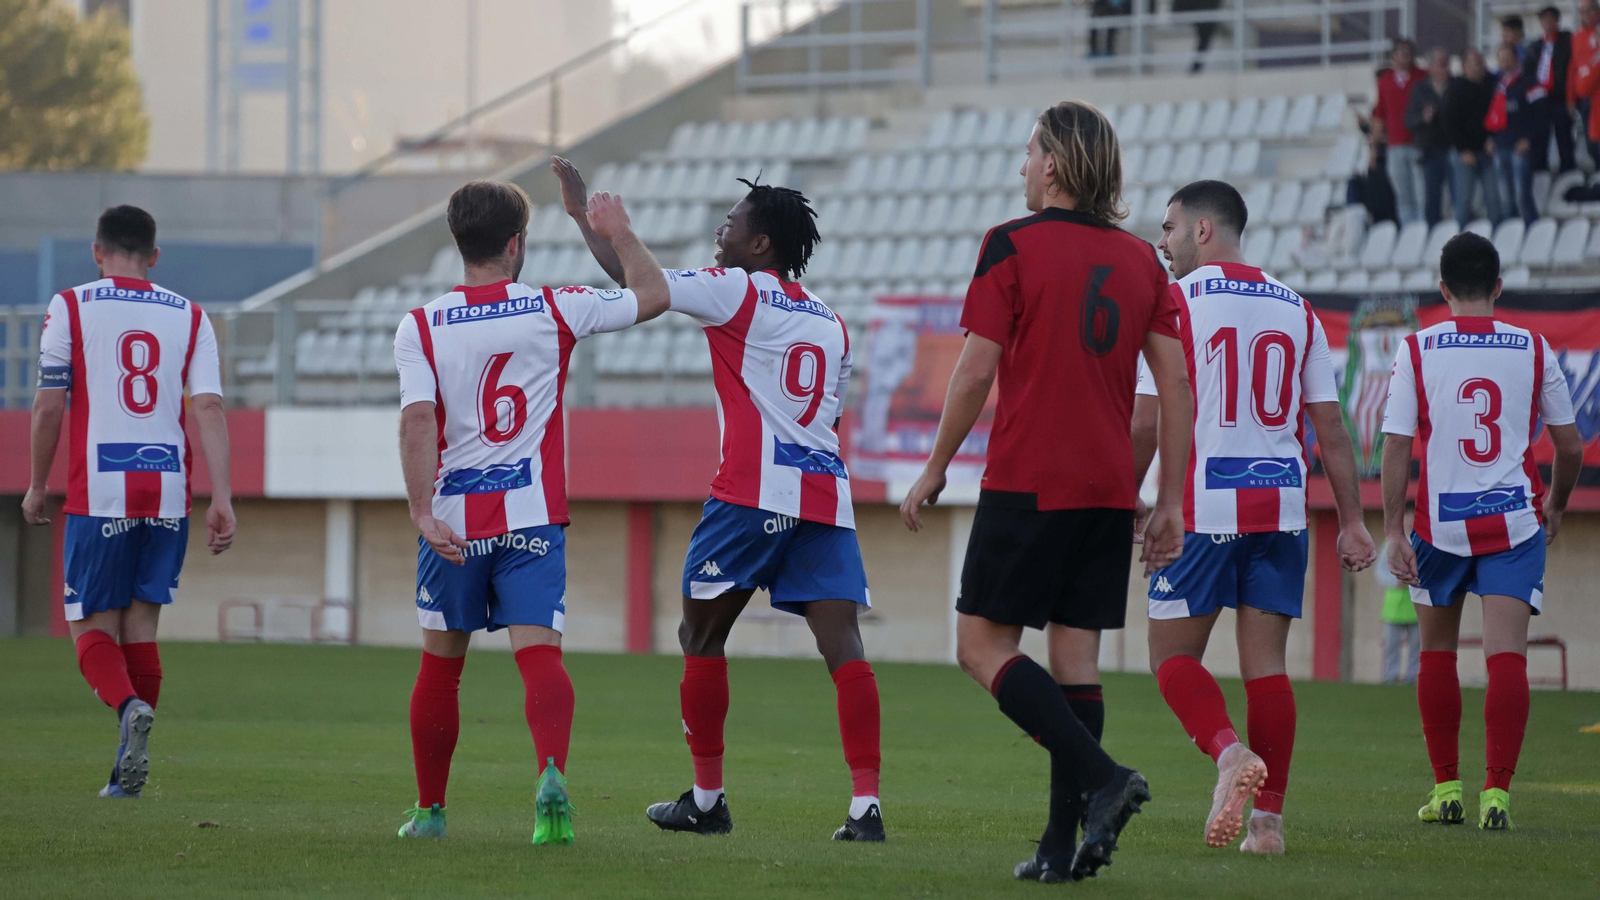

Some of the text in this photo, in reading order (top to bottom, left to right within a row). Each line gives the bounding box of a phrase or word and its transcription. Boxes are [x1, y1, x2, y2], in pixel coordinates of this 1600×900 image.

[99, 287, 184, 305] STOP-FLUID
[1210, 279, 1298, 301] STOP-FLUID
[451, 299, 541, 319] STOP-FLUID
[1079, 264, 1120, 358] 6
[1441, 334, 1526, 346] STOP-FLUID
[116, 329, 160, 418] 8
[780, 341, 826, 428] 9
[1205, 327, 1296, 432] 10
[476, 351, 527, 447] 6
[1457, 377, 1502, 468] 3
[479, 478, 526, 491] MUELLS
[1249, 476, 1299, 486] MUELLES
[1477, 502, 1523, 515] MUELLES
